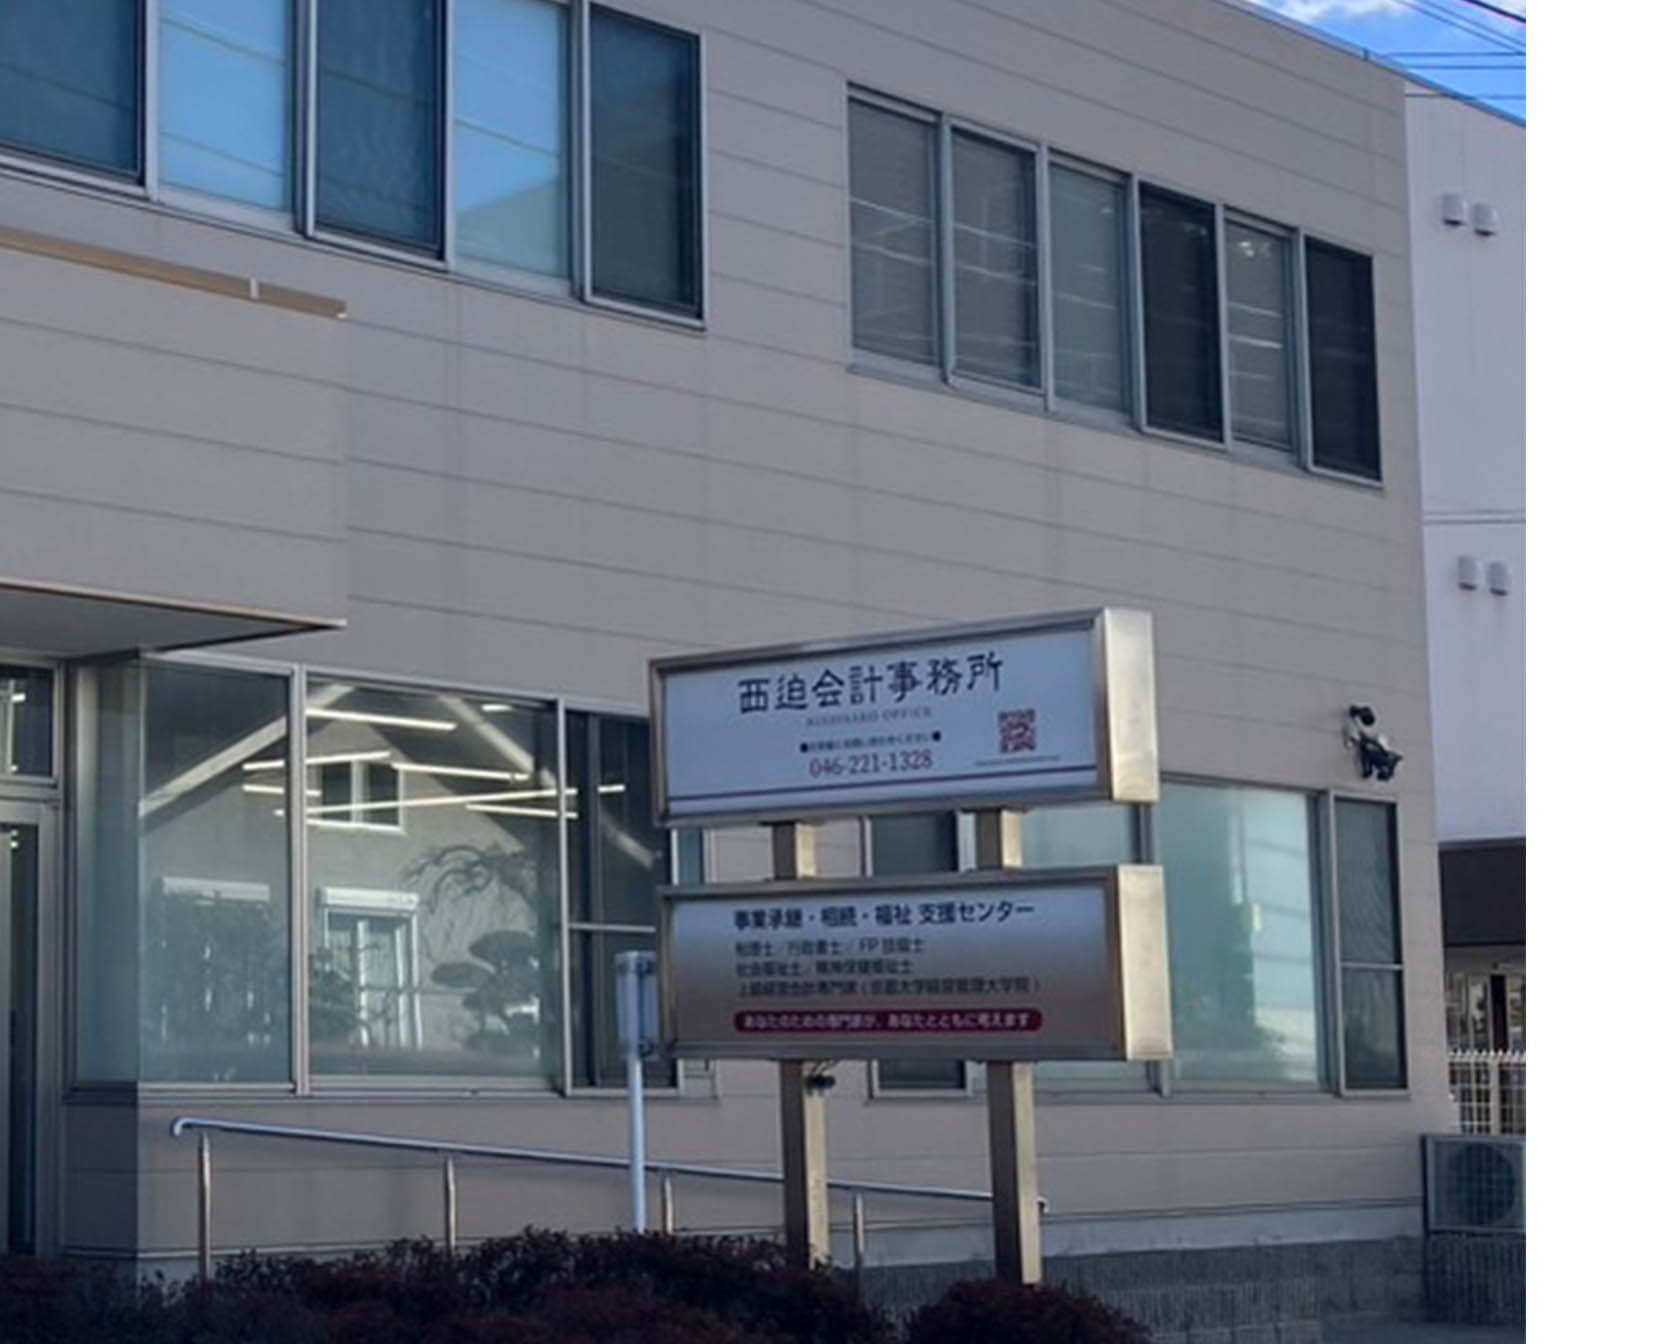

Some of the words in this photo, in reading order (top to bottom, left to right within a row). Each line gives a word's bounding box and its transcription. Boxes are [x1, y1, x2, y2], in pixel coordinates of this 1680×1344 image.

[738, 651, 1004, 714] 西迫会計事務所
[809, 749, 933, 778] 046-221-1328
